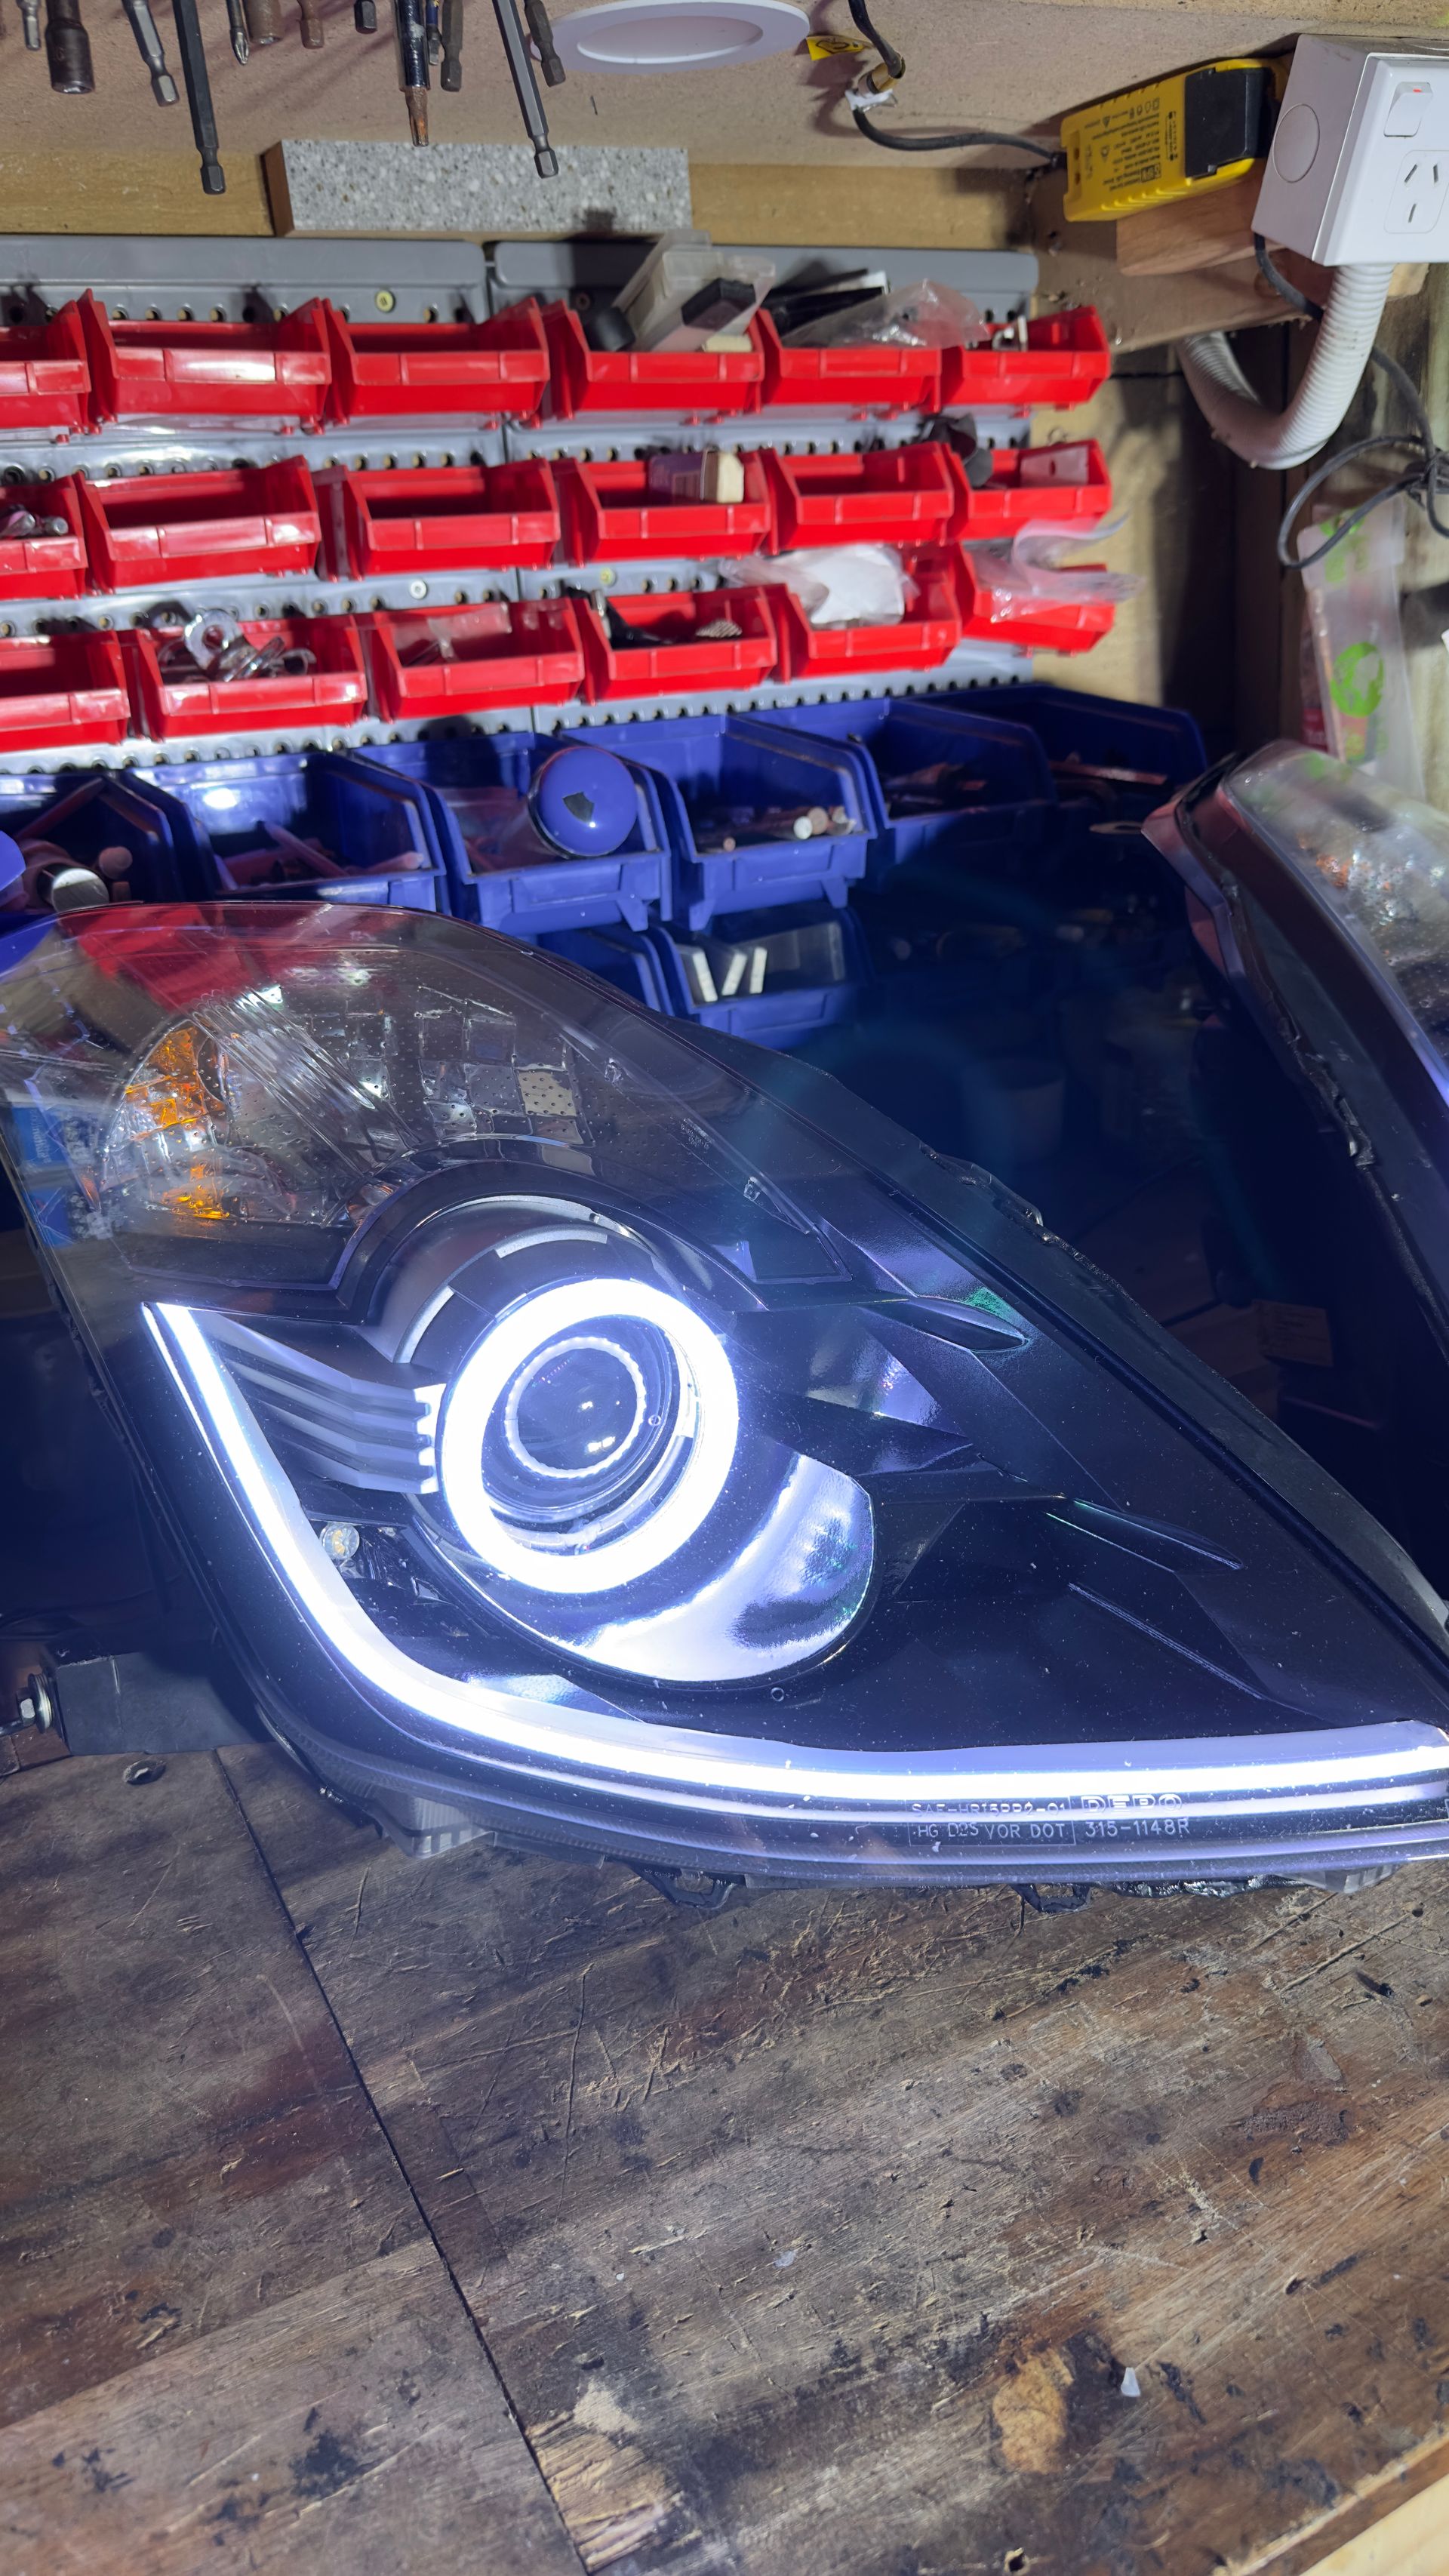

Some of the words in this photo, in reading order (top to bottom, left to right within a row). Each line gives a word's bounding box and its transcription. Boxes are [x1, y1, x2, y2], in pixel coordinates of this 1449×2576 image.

[1081, 1793, 1182, 1813] DEPO
[918, 1824, 939, 1838] HG
[984, 1824, 1021, 1839] VOR
[1030, 1823, 1066, 1838] DOT
[1085, 1817, 1190, 1837] 315-1148R
